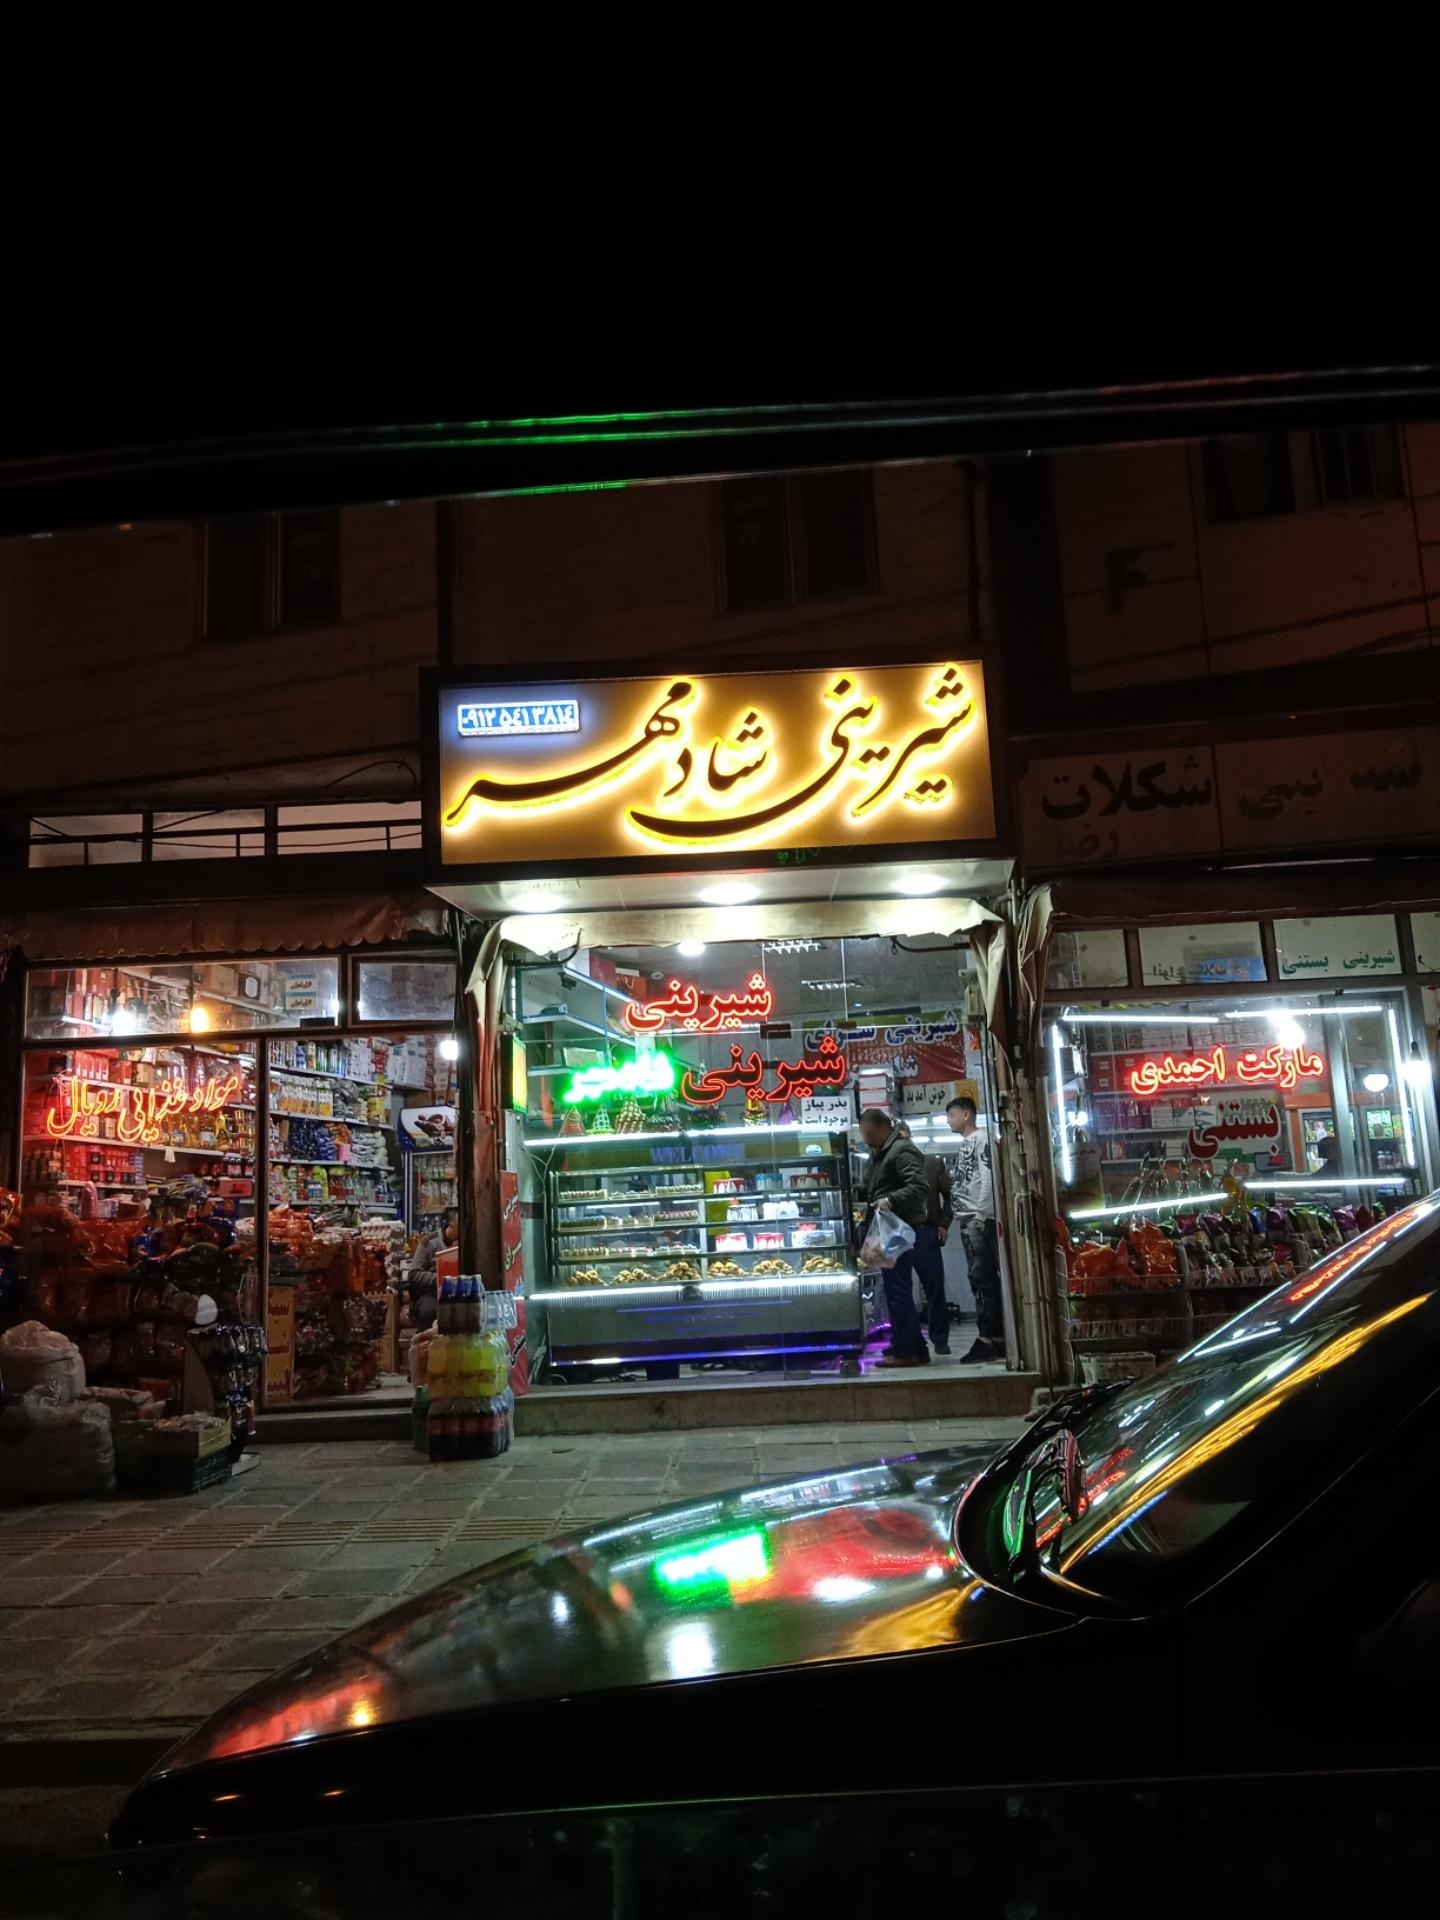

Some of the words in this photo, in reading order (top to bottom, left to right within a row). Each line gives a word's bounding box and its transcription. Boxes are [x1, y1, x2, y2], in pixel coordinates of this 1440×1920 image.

[630, 664, 972, 838] شیرینی
[1041, 754, 1213, 821] شکلات
[1281, 953, 1330, 976] بستنی
[1342, 948, 1395, 970] شیرینی
[625, 973, 773, 1032] شیرینی
[885, 1009, 961, 1046] شیرینی
[681, 1036, 847, 1105] شیرینی
[1131, 1046, 1226, 1095] احمدی
[1235, 1044, 1324, 1088] مارکت
[47, 1075, 120, 1137] رویال
[117, 1076, 189, 1142] غذایی
[189, 1076, 240, 1113] مواد
[805, 1098, 825, 1112] پیاز
[827, 1098, 848, 1112] بذر
[929, 1087, 946, 1105] خوش
[805, 1113, 823, 1125] است
[823, 1115, 849, 1127] موجود
[1187, 1102, 1281, 1160] بستنی
